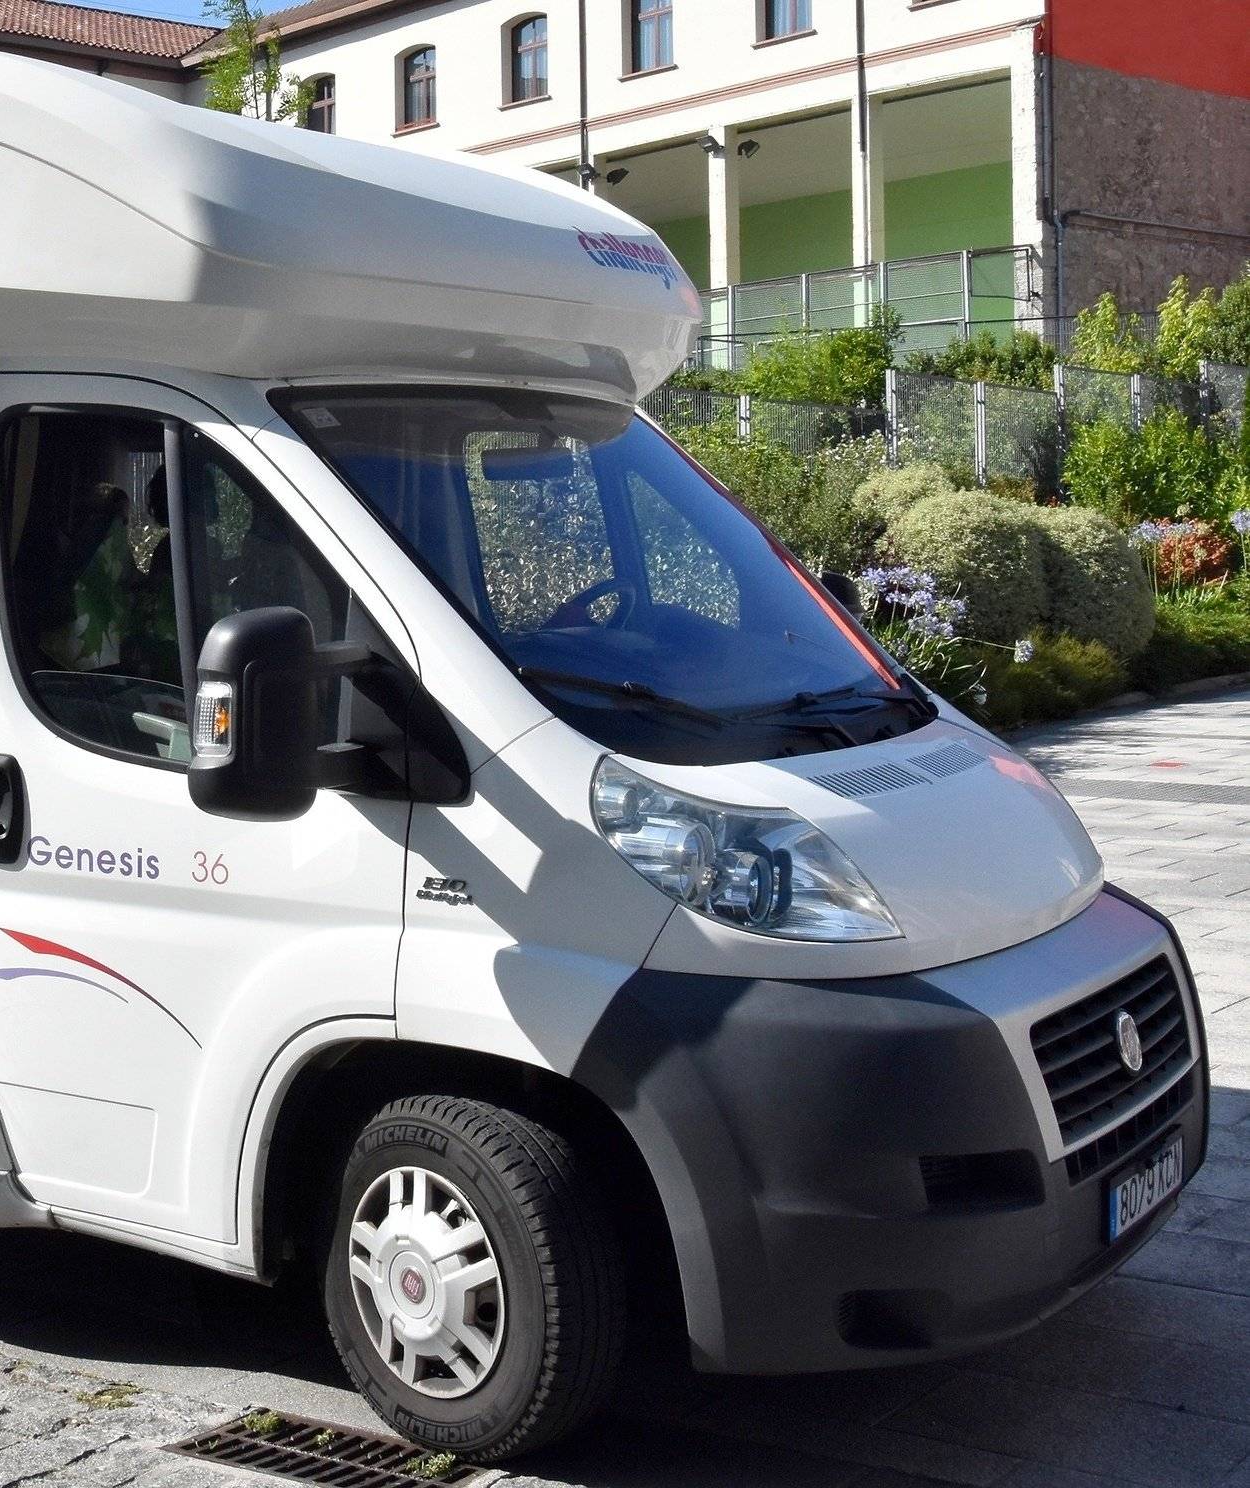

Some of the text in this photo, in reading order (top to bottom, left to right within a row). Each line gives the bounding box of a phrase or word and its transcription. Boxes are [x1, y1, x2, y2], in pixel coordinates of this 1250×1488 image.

[29, 835, 229, 885] Genesis 36
[364, 1125, 448, 1153] MICHELIN
[1120, 1167, 1154, 1226] 8079
[396, 1408, 483, 1443] MICHELIN
